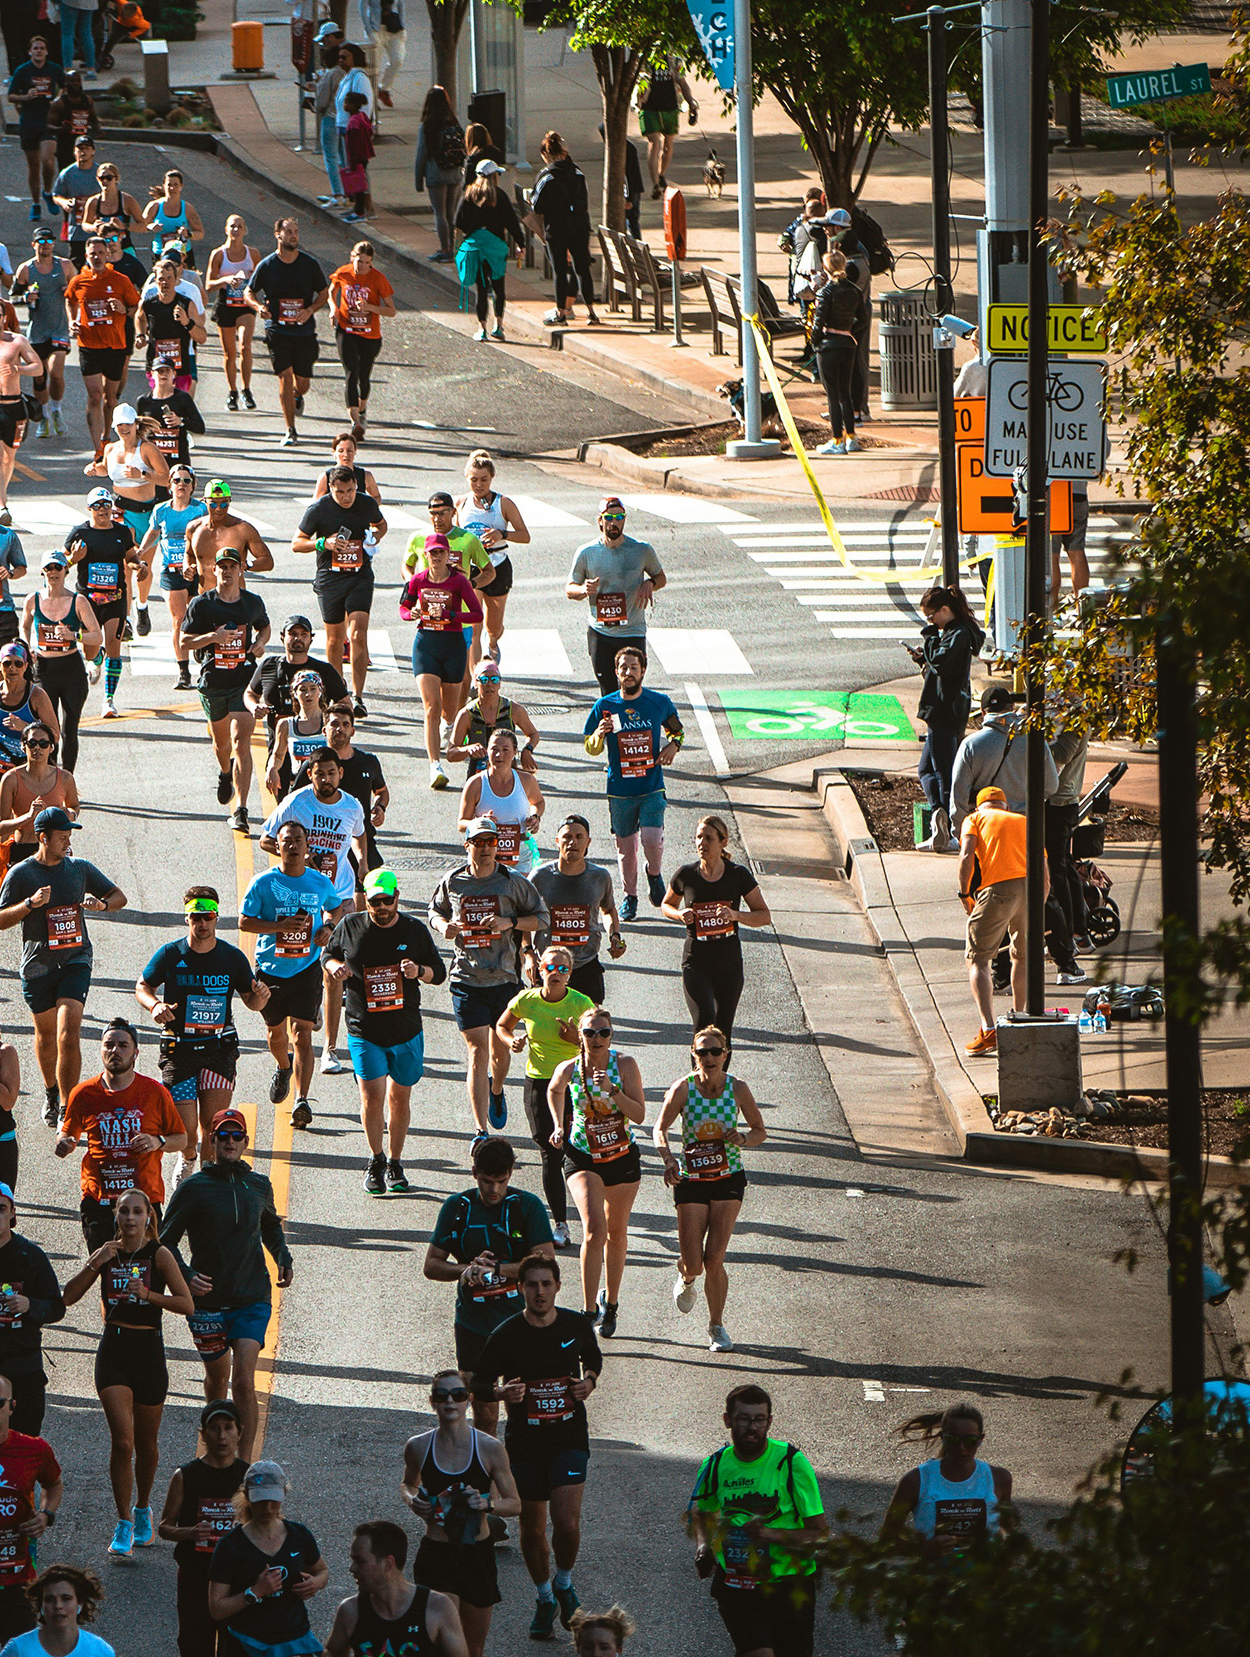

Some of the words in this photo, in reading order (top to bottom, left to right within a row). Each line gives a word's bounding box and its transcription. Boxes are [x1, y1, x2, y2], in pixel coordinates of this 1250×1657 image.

[1114, 73, 1182, 103] LAUREL
[1190, 78, 1203, 90] ST
[1002, 315, 1094, 342] NICE
[1003, 421, 1028, 438] MA
[1054, 422, 1088, 441] USE
[993, 449, 1025, 467] FUL
[1052, 451, 1096, 469] LANE
[600, 606, 622, 614] 4430
[621, 719, 652, 730] ANSAS
[623, 745, 649, 755] 14142
[313, 814, 342, 831] 1907
[308, 837, 341, 850] RACING
[498, 840, 514, 848] 001
[320, 870, 332, 878] 68
[54, 921, 76, 931] 1808
[555, 920, 585, 929] 14805
[282, 931, 307, 940] 3208
[371, 983, 397, 993] 2338
[192, 1011, 220, 1020] 21917
[99, 1118, 141, 1134] NASH
[101, 1134, 132, 1146] VILL
[596, 1131, 618, 1144] 1616
[691, 1154, 723, 1168] 13639
[104, 1179, 135, 1189] 14126
[536, 1399, 565, 1409] 1592
